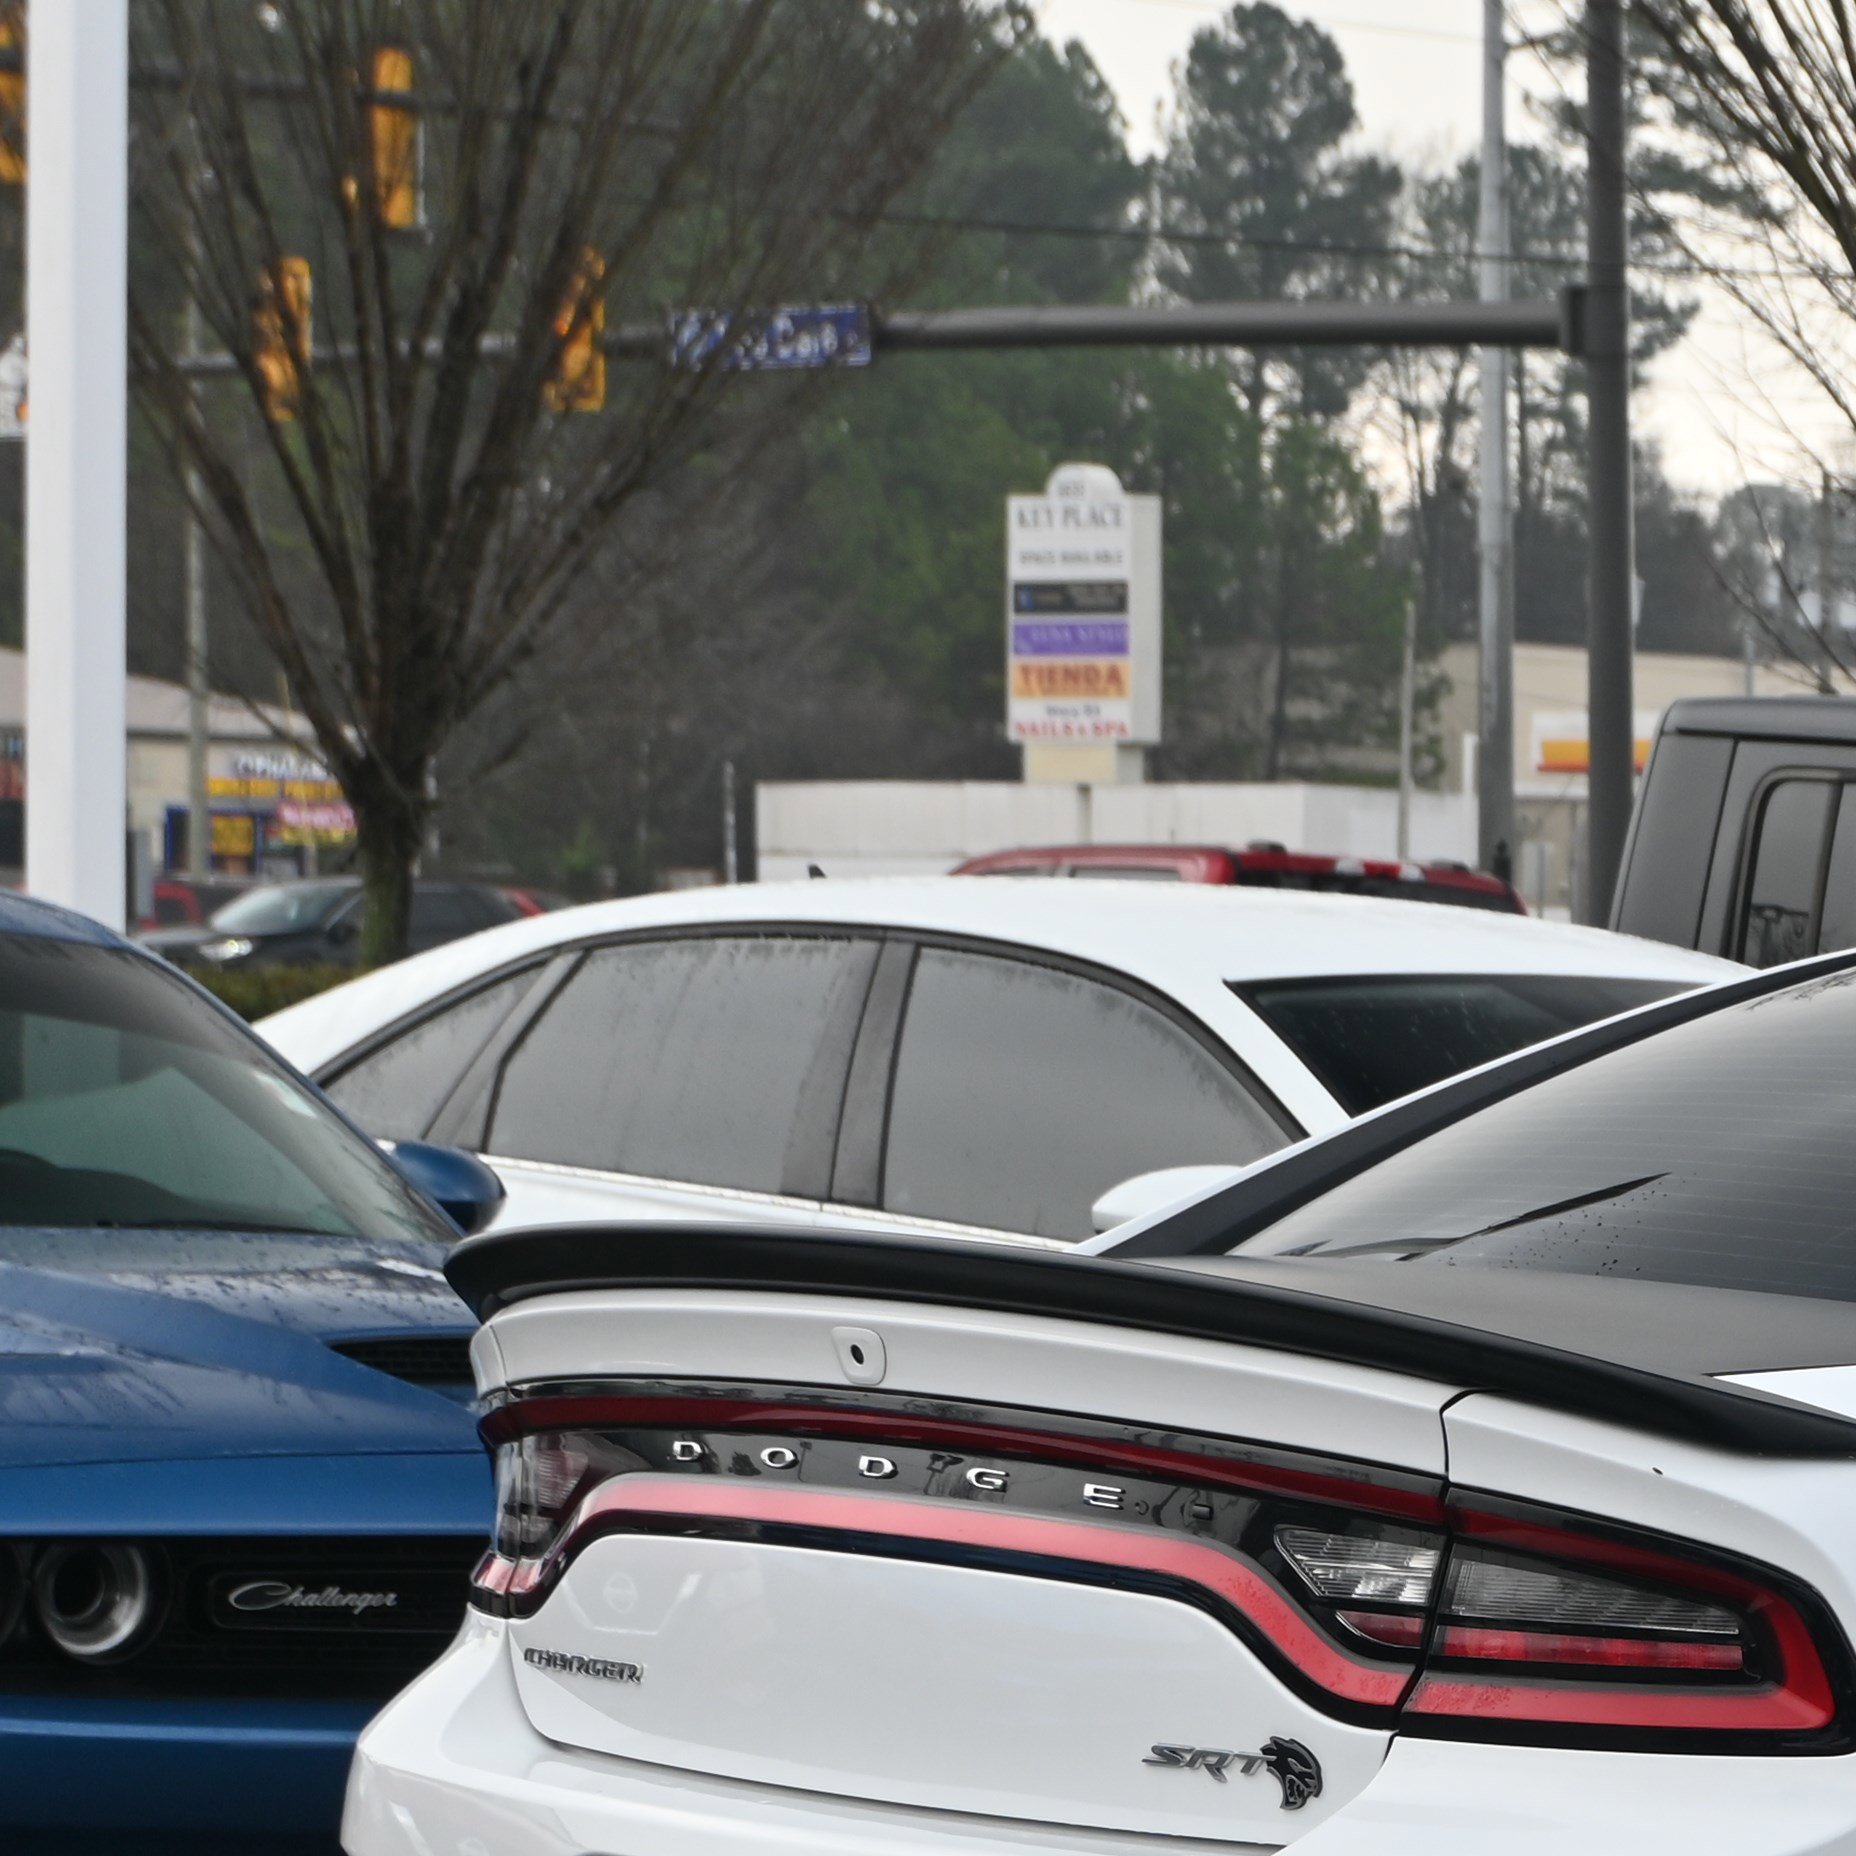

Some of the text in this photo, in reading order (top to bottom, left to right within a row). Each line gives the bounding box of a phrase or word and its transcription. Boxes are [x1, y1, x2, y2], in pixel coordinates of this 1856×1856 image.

[1019, 664, 1124, 693] TIENDA
[1016, 721, 1073, 737] NAILS
[1094, 721, 1129, 737] SPA
[672, 1440, 1125, 1509] DODGE
[228, 1581, 398, 1615] Challenger
[524, 1647, 643, 1683] CHARGER
[1142, 1743, 1278, 1784] SRT
